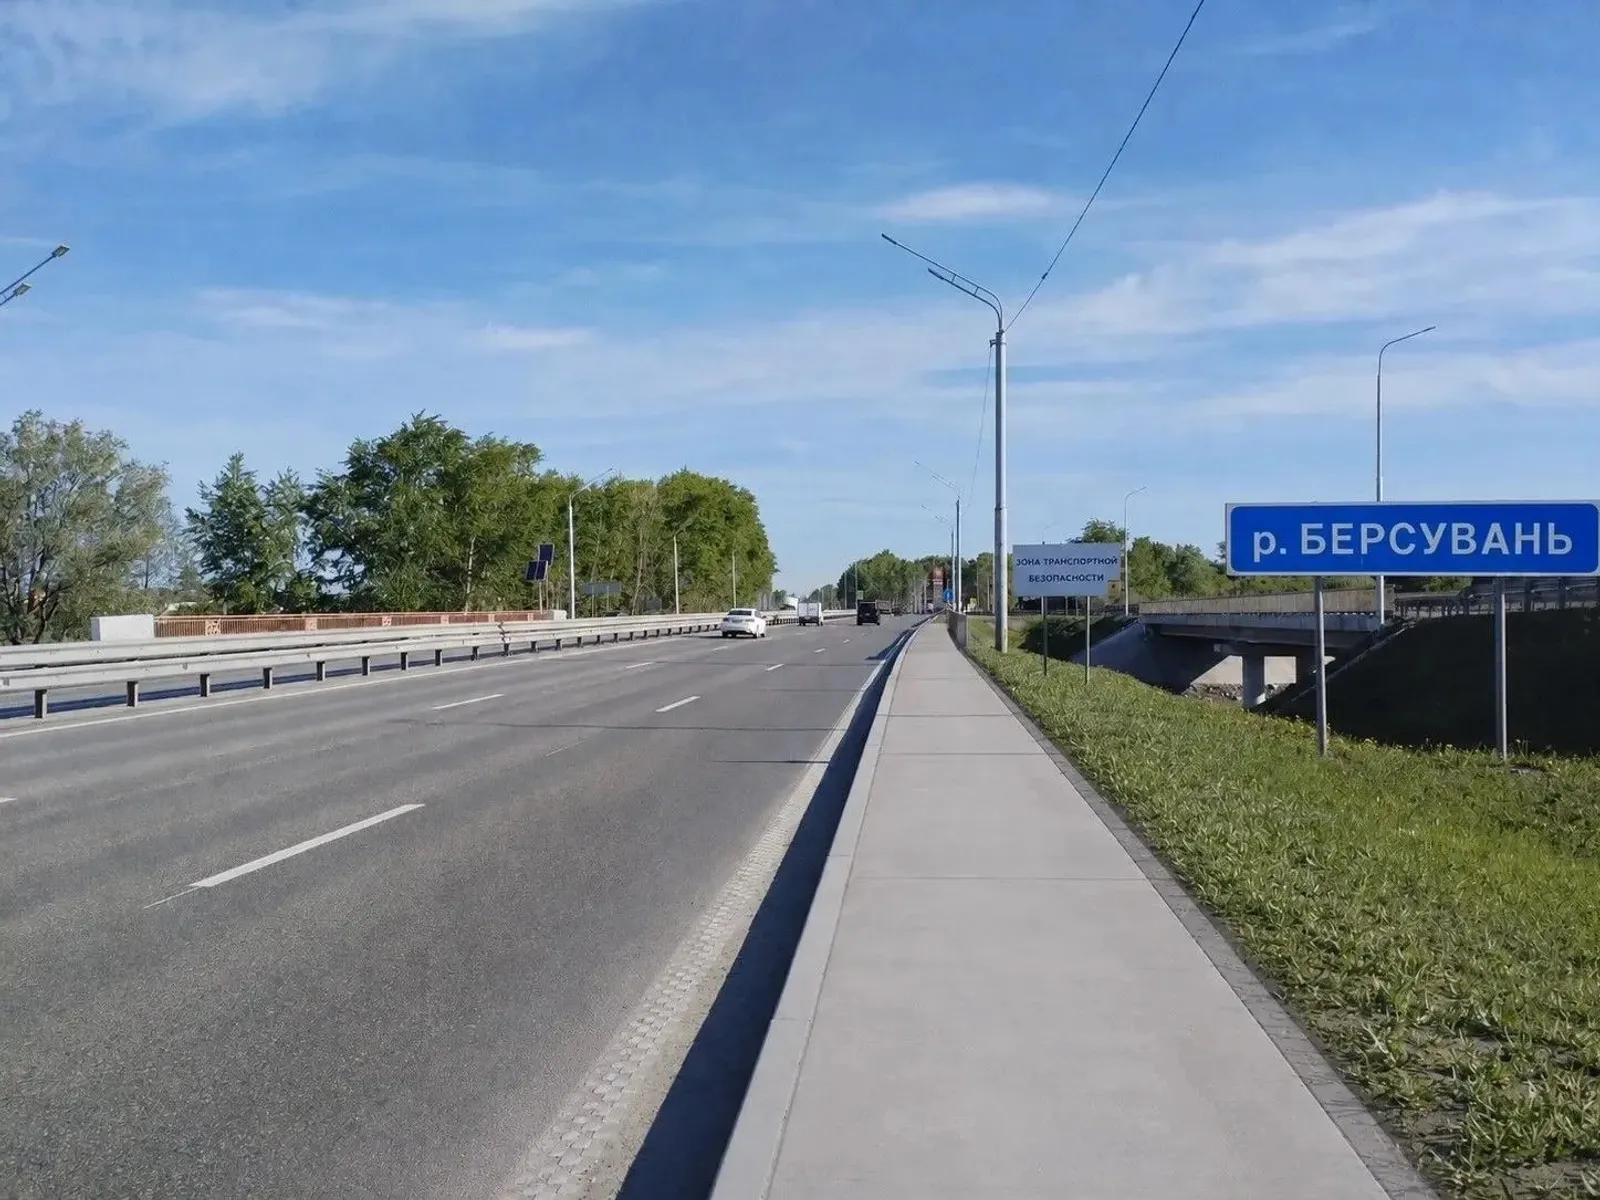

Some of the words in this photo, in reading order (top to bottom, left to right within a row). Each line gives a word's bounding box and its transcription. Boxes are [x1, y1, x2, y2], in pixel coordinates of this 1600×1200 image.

[1254, 531, 1286, 562] р.
[1301, 522, 1573, 555] БЕРСУВАНЬ
[1016, 558, 1041, 566] ЗОНА
[1043, 556, 1118, 566] ТРАНСПОРТНОЙ
[1028, 574, 1104, 583] БЕЗОПАСНОСТИ
